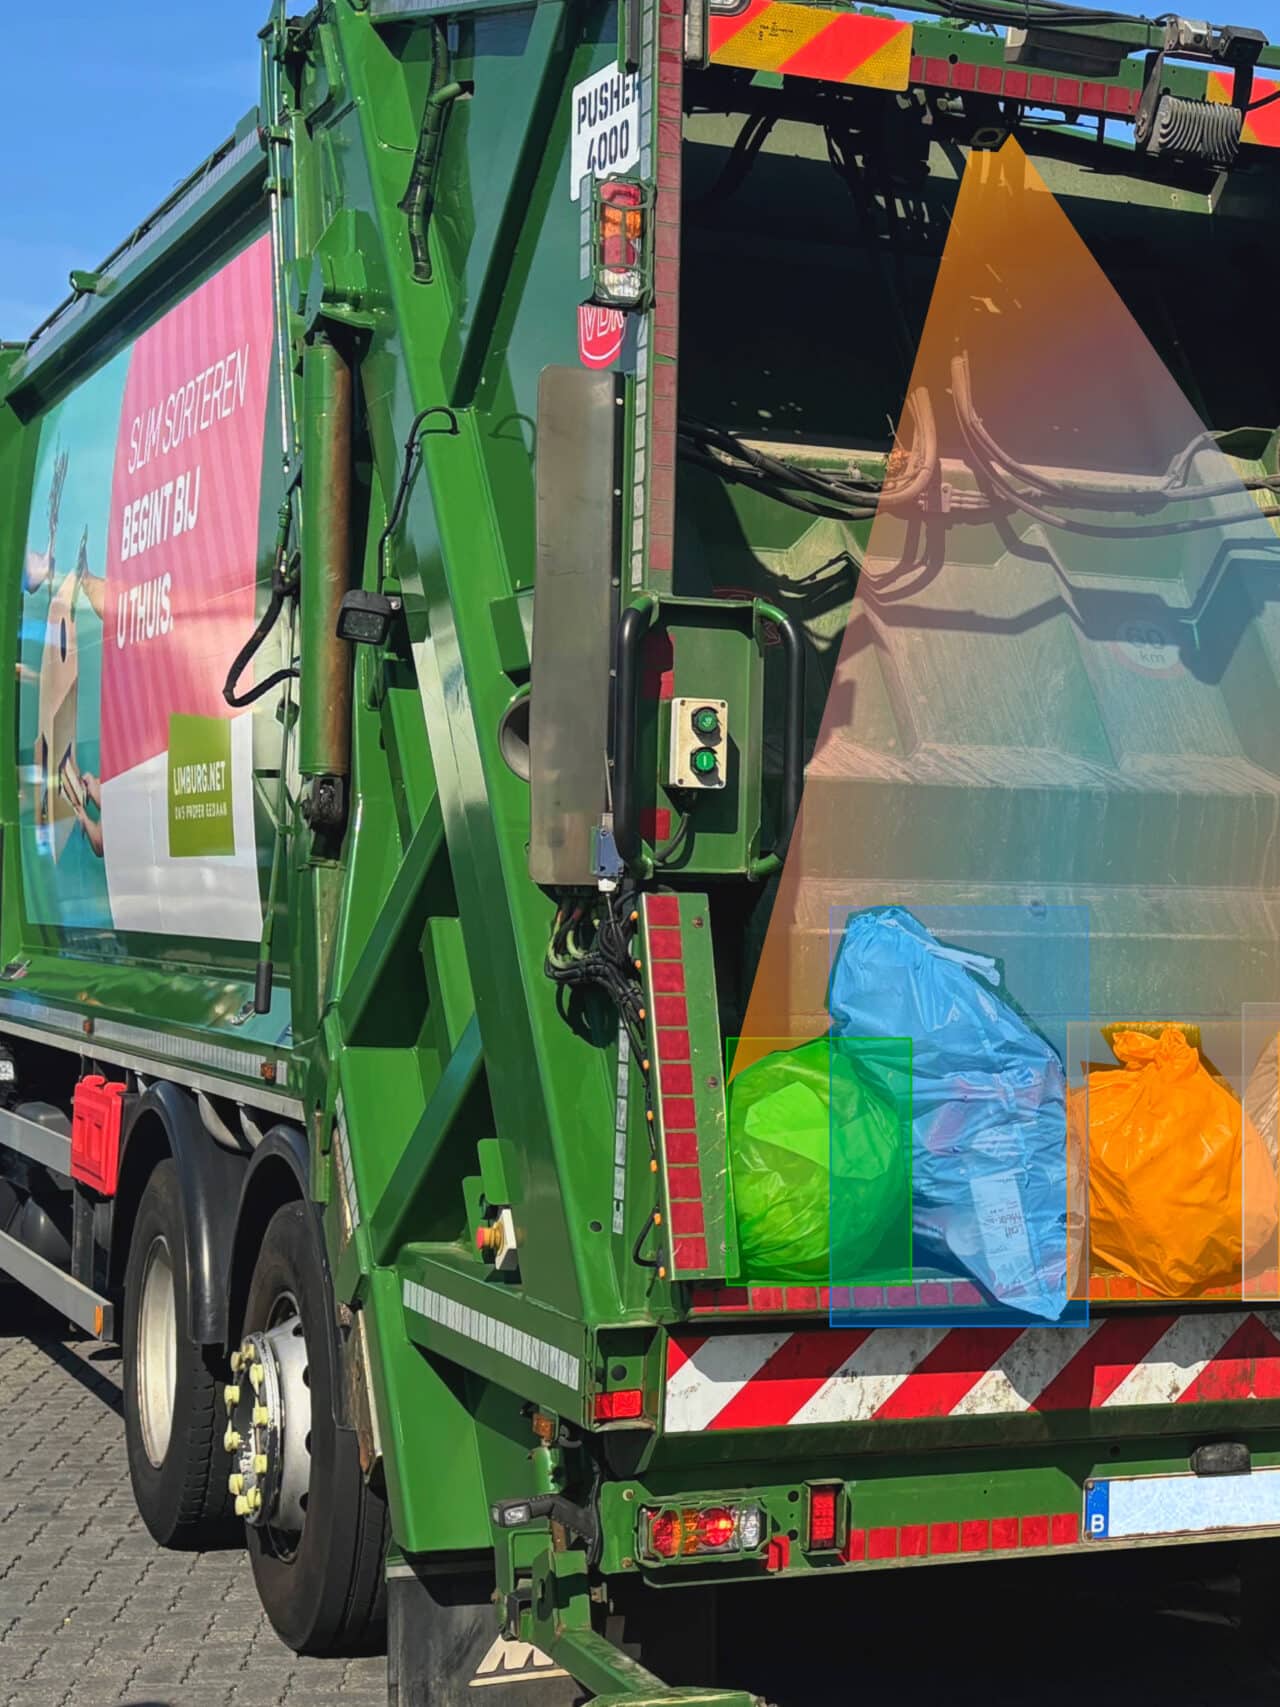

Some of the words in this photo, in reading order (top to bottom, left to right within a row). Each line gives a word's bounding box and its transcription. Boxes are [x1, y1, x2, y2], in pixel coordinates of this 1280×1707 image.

[587, 119, 630, 171] 4000
[128, 400, 163, 475] SLIM
[162, 343, 249, 455] SORTEREN
[121, 480, 174, 562] BEGINT
[173, 465, 201, 537] BIJ
[117, 591, 128, 650] U
[129, 572, 174, 645] THUIS.
[173, 760, 226, 796] LIMBURG.NET
[1091, 1513, 1105, 1533] B
